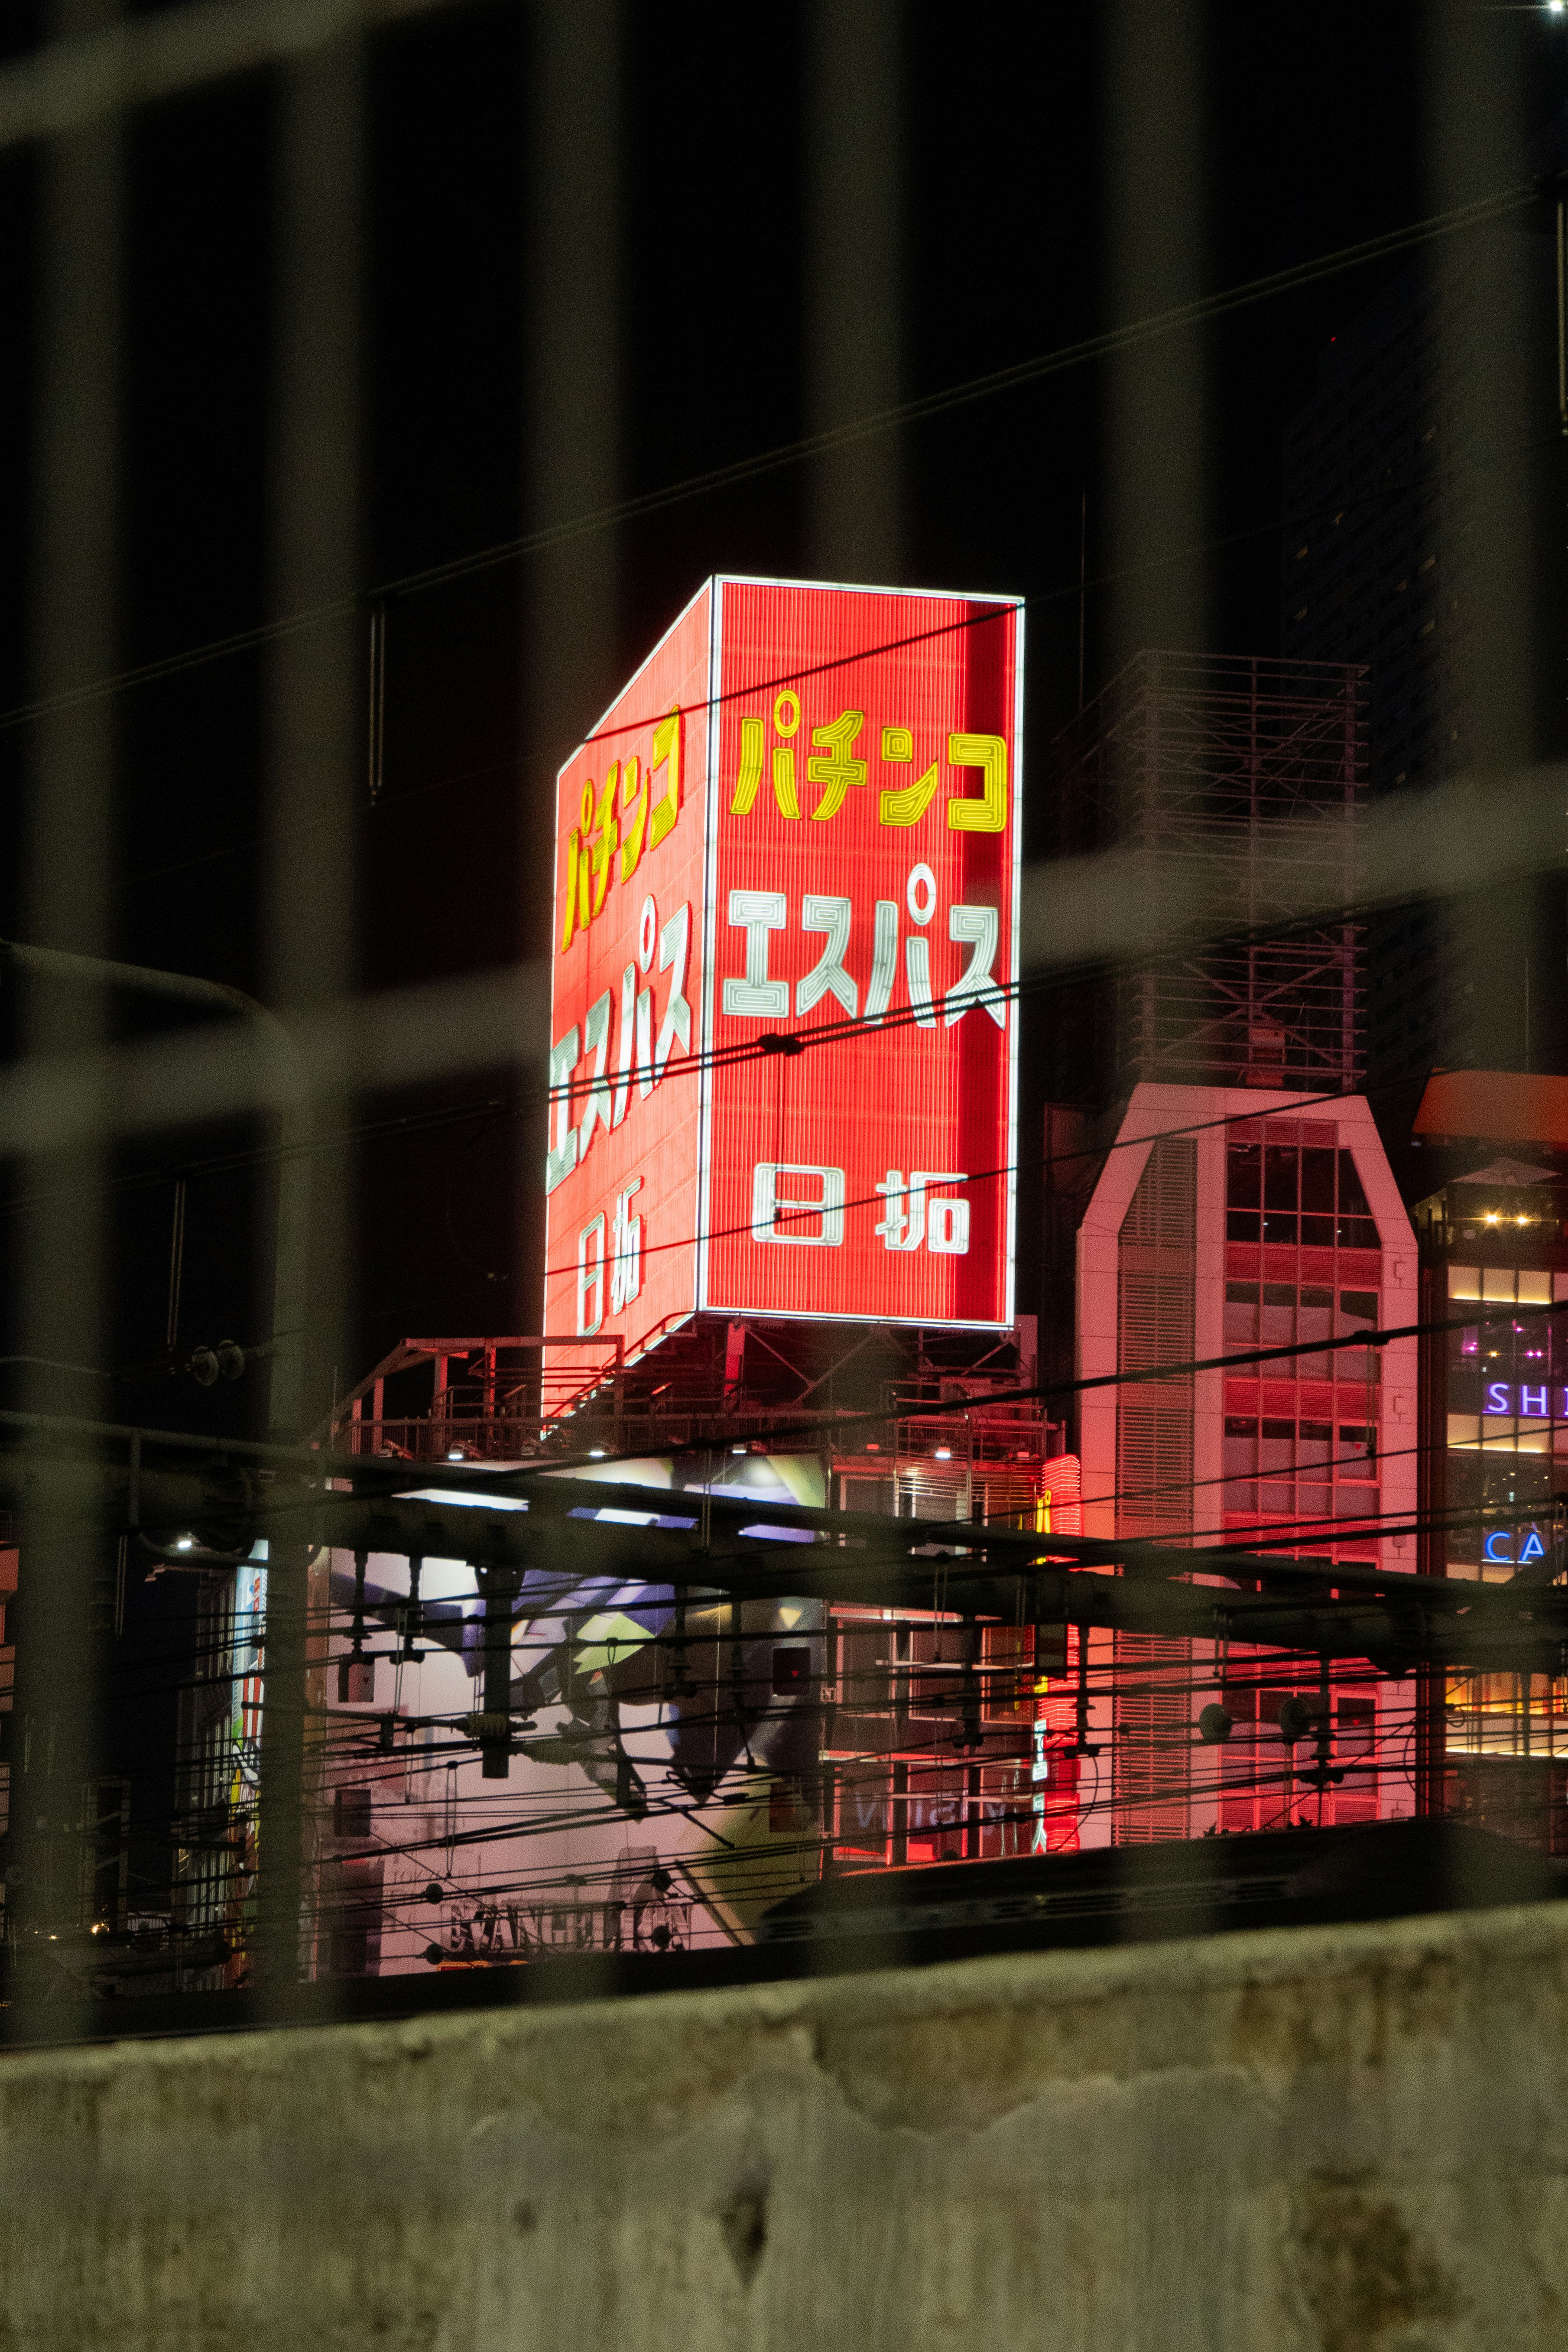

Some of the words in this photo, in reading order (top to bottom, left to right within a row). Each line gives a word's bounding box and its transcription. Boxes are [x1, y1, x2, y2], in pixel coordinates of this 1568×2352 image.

[562, 705, 683, 953] パチンコ
[730, 689, 1007, 833] パチンコ
[721, 862, 1006, 1031] エスパス
[546, 893, 691, 1195] エスパス
[576, 1176, 643, 1336] 日拓
[751, 1162, 971, 1255] 日拓
